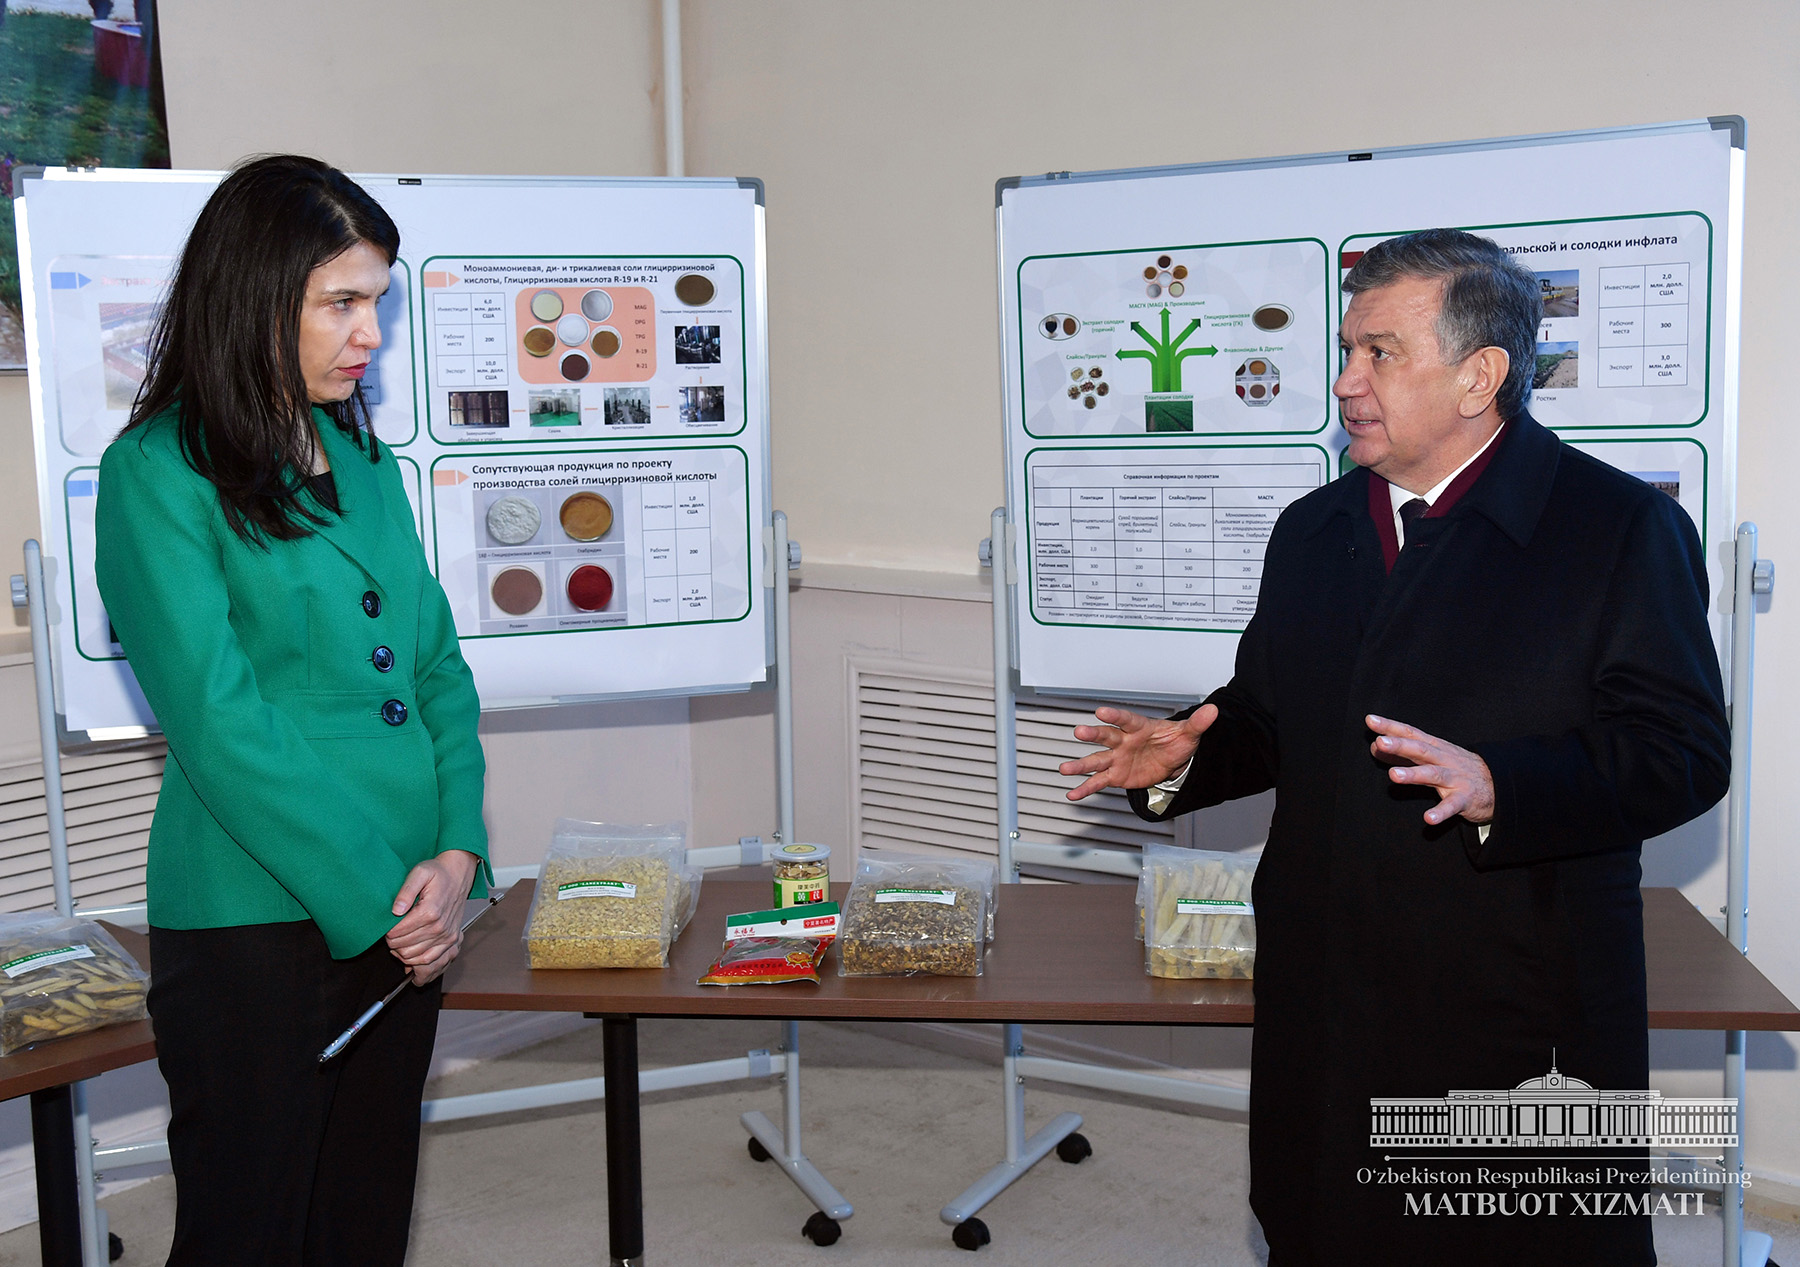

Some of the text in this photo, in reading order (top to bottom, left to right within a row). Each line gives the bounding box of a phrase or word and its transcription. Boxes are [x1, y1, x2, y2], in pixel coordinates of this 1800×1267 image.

[1501, 236, 1677, 254] ральской и солодки инфлата
[463, 265, 544, 273] Моноаммониевая,
[546, 265, 560, 273] ди-
[569, 264, 621, 273] трикалиевая
[623, 264, 642, 272] соли
[644, 263, 715, 272] глицирризиновой
[464, 276, 502, 285] кислоты,
[504, 275, 578, 285] Глицирризиновая
[580, 276, 612, 284] кислота
[614, 275, 632, 283] R-19
[640, 275, 658, 283] R-21
[472, 463, 554, 475] Сопутствующая
[557, 462, 613, 472] продукция
[632, 460, 672, 470] проекту
[473, 472, 717, 490] производства солей глицирризиновой кислоты
